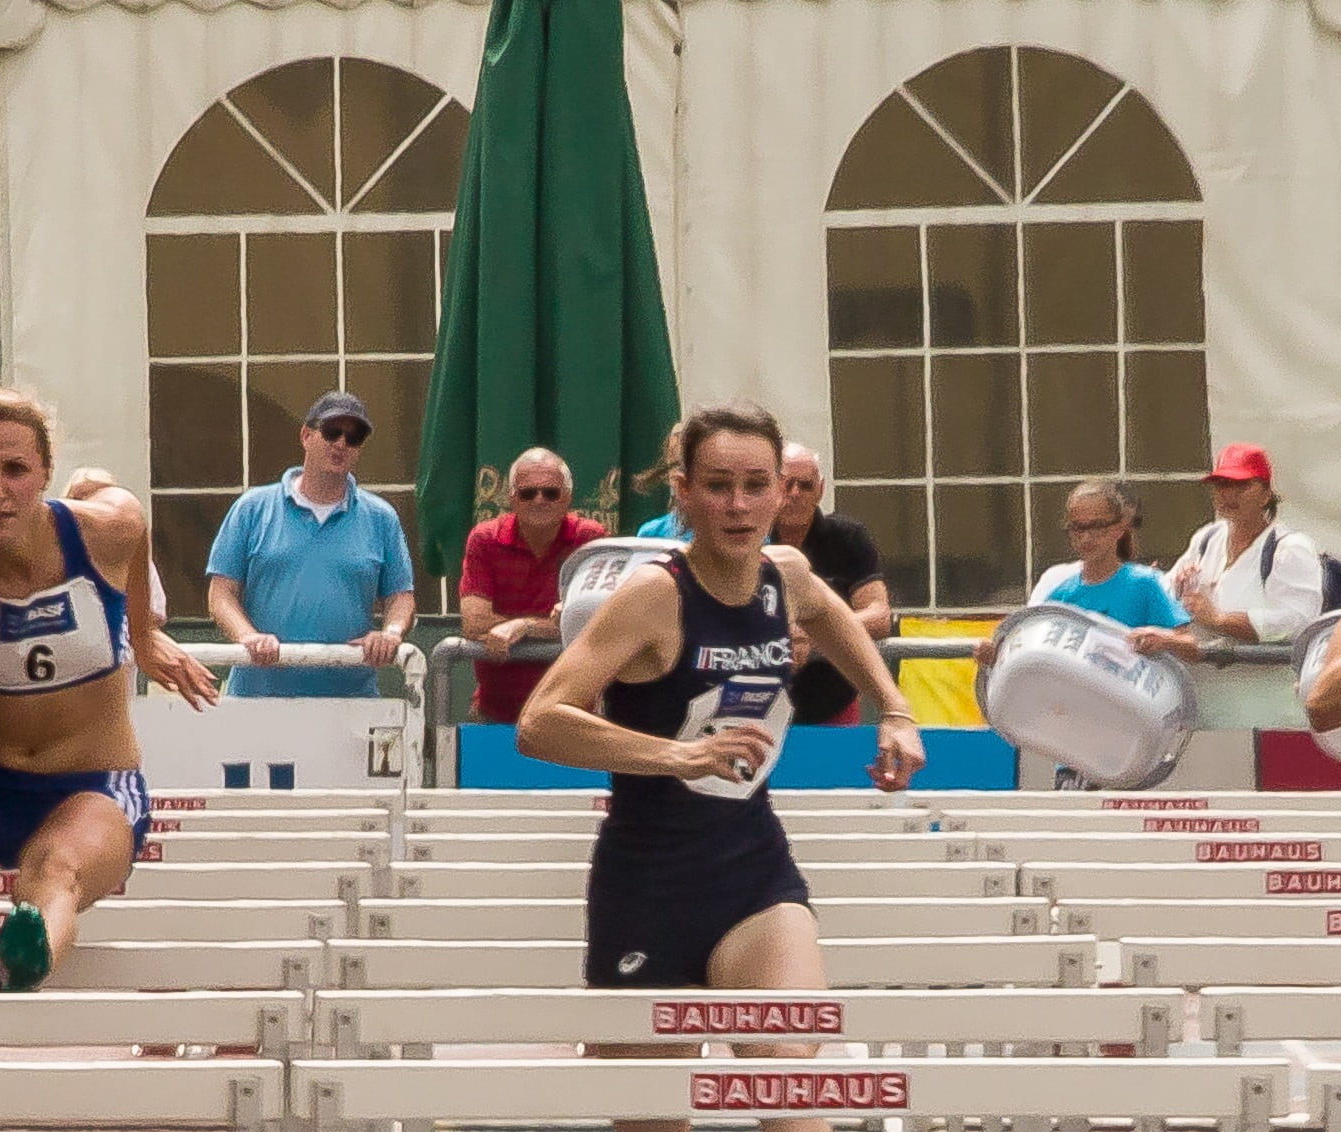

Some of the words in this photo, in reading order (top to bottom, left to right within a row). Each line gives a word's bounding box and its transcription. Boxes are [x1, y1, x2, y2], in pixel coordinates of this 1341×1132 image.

[26, 644, 56, 682] 6
[1197, 843, 1320, 861] BAUHAUS
[656, 1005, 840, 1030] BAUHAUS
[693, 1077, 905, 1105] BAUHAUS
